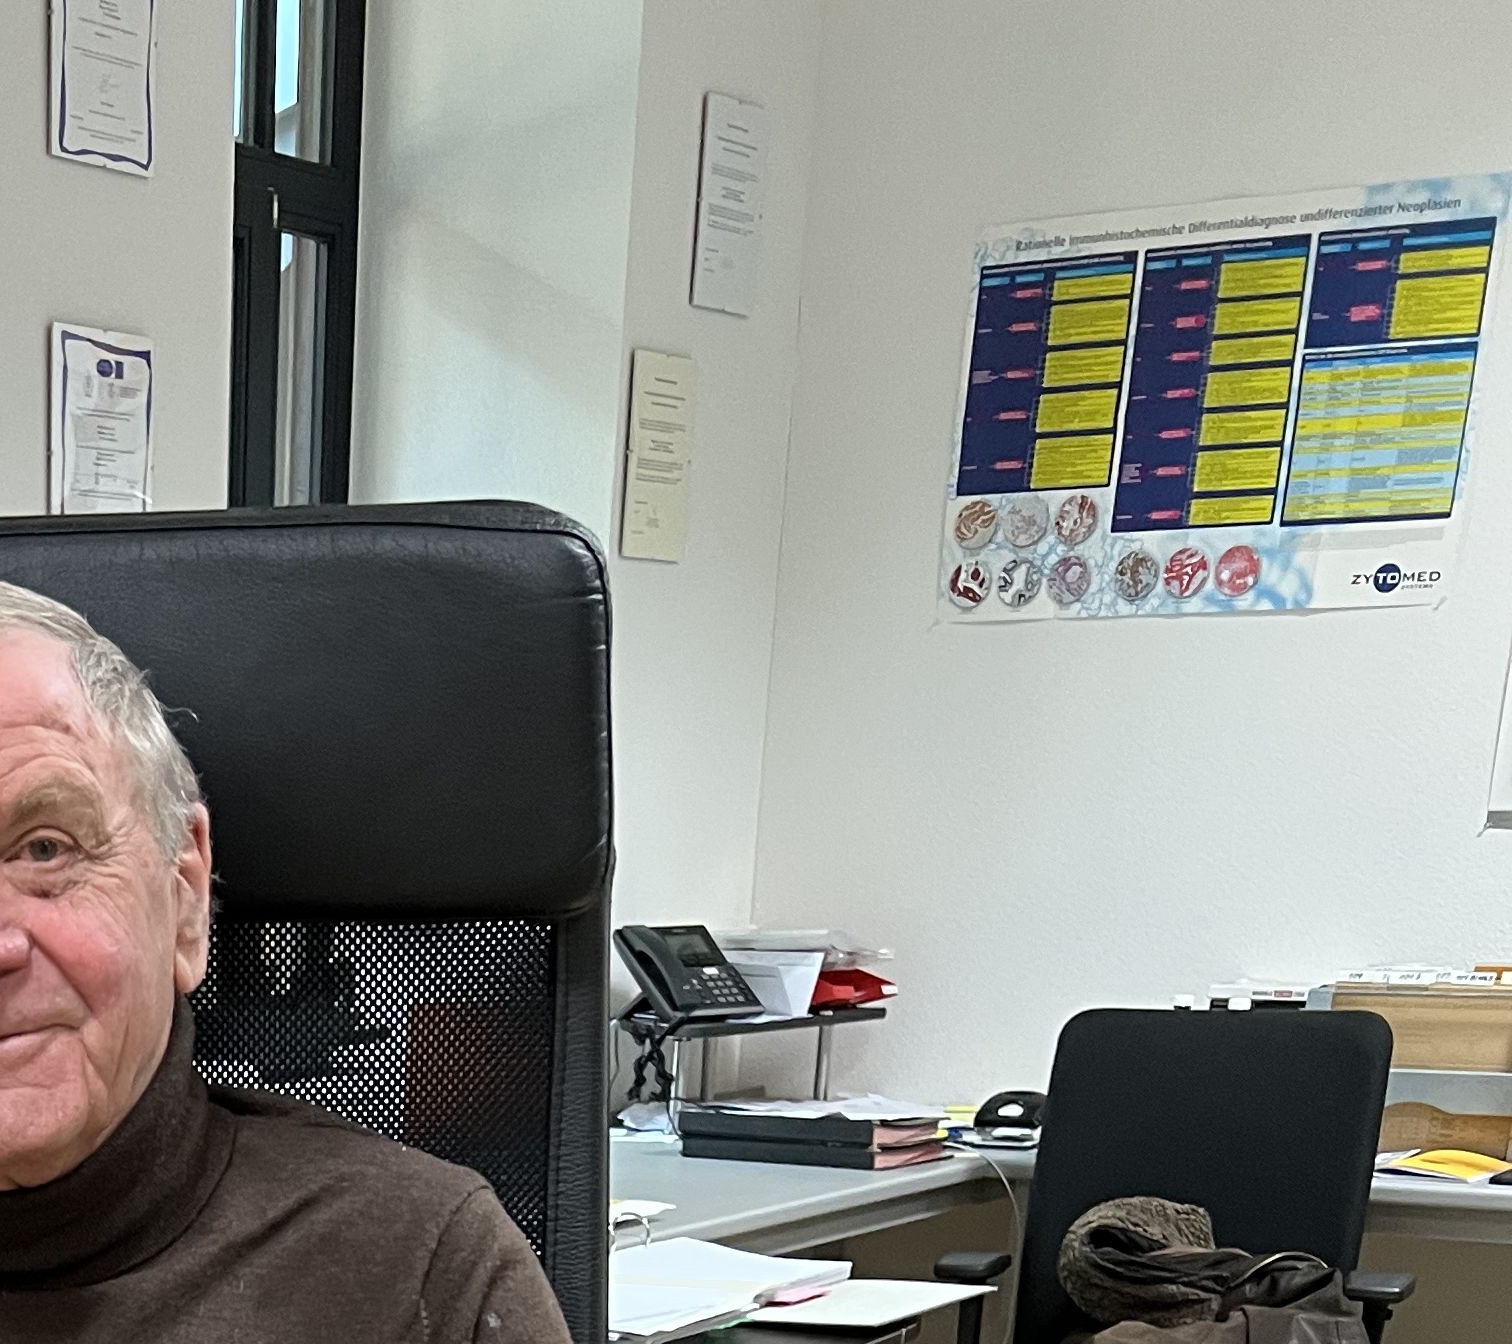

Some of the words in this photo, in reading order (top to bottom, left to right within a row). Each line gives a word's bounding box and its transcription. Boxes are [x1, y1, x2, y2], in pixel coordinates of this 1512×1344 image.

[1299, 205, 1394, 223] undifferenzierter
[1396, 197, 1462, 214] Neoplasien
[1351, 571, 1441, 585] ZYTOMED
